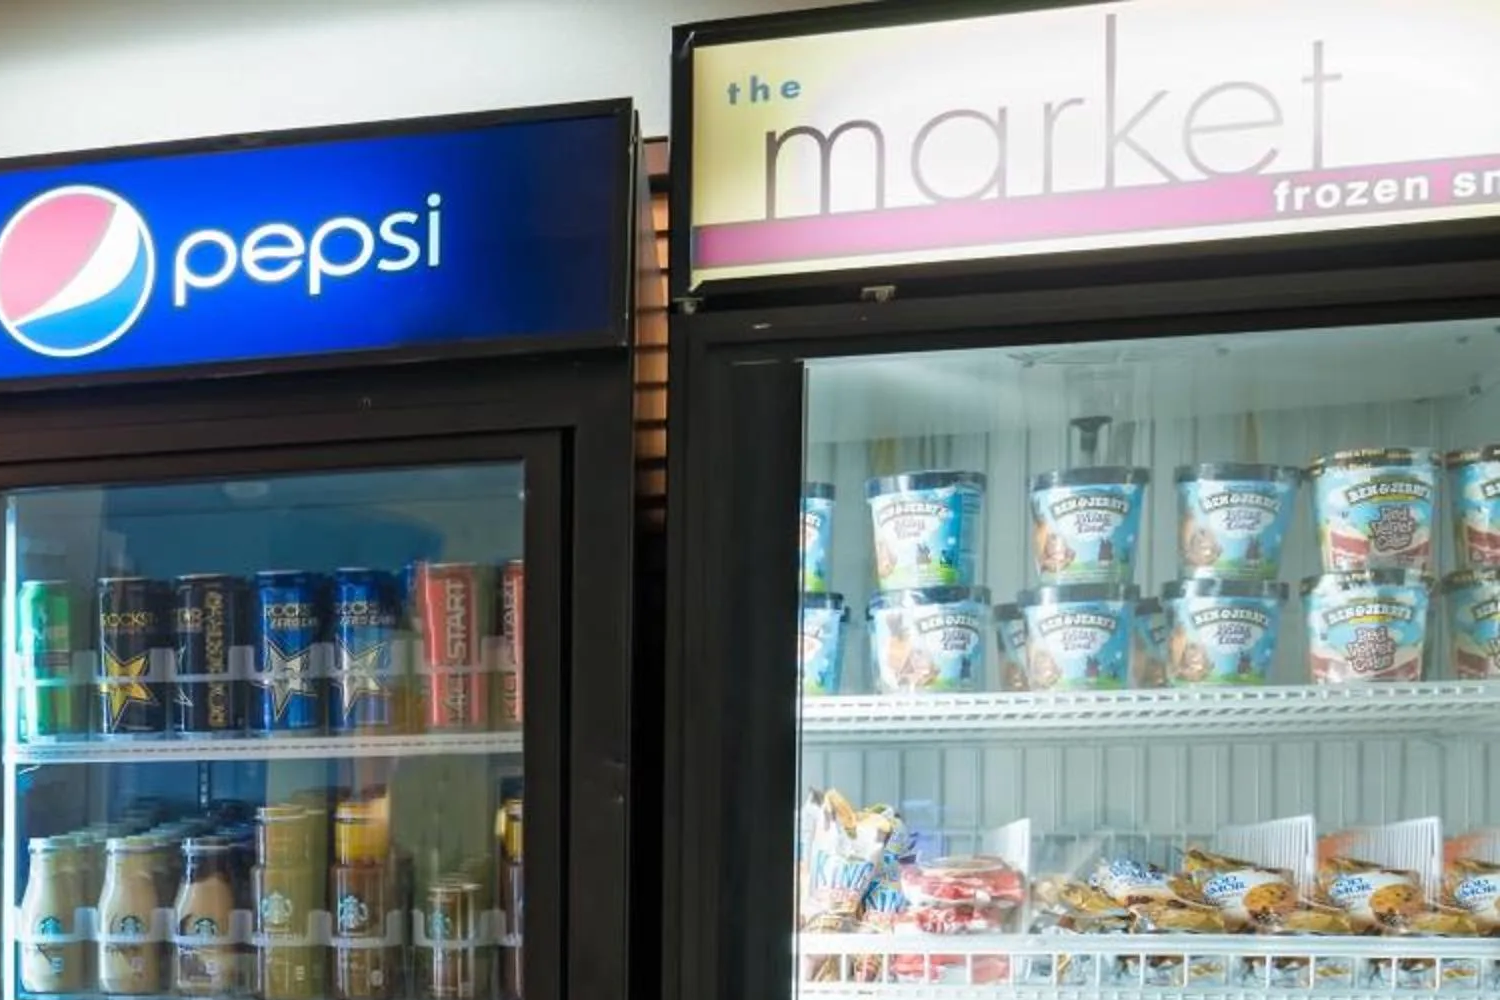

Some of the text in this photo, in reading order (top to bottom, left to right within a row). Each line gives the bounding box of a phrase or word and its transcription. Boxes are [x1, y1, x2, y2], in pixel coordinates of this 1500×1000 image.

[727, 74, 802, 106] the
[766, 13, 1343, 220] market
[1273, 174, 1429, 213] frozen
[174, 192, 442, 308] pepsi
